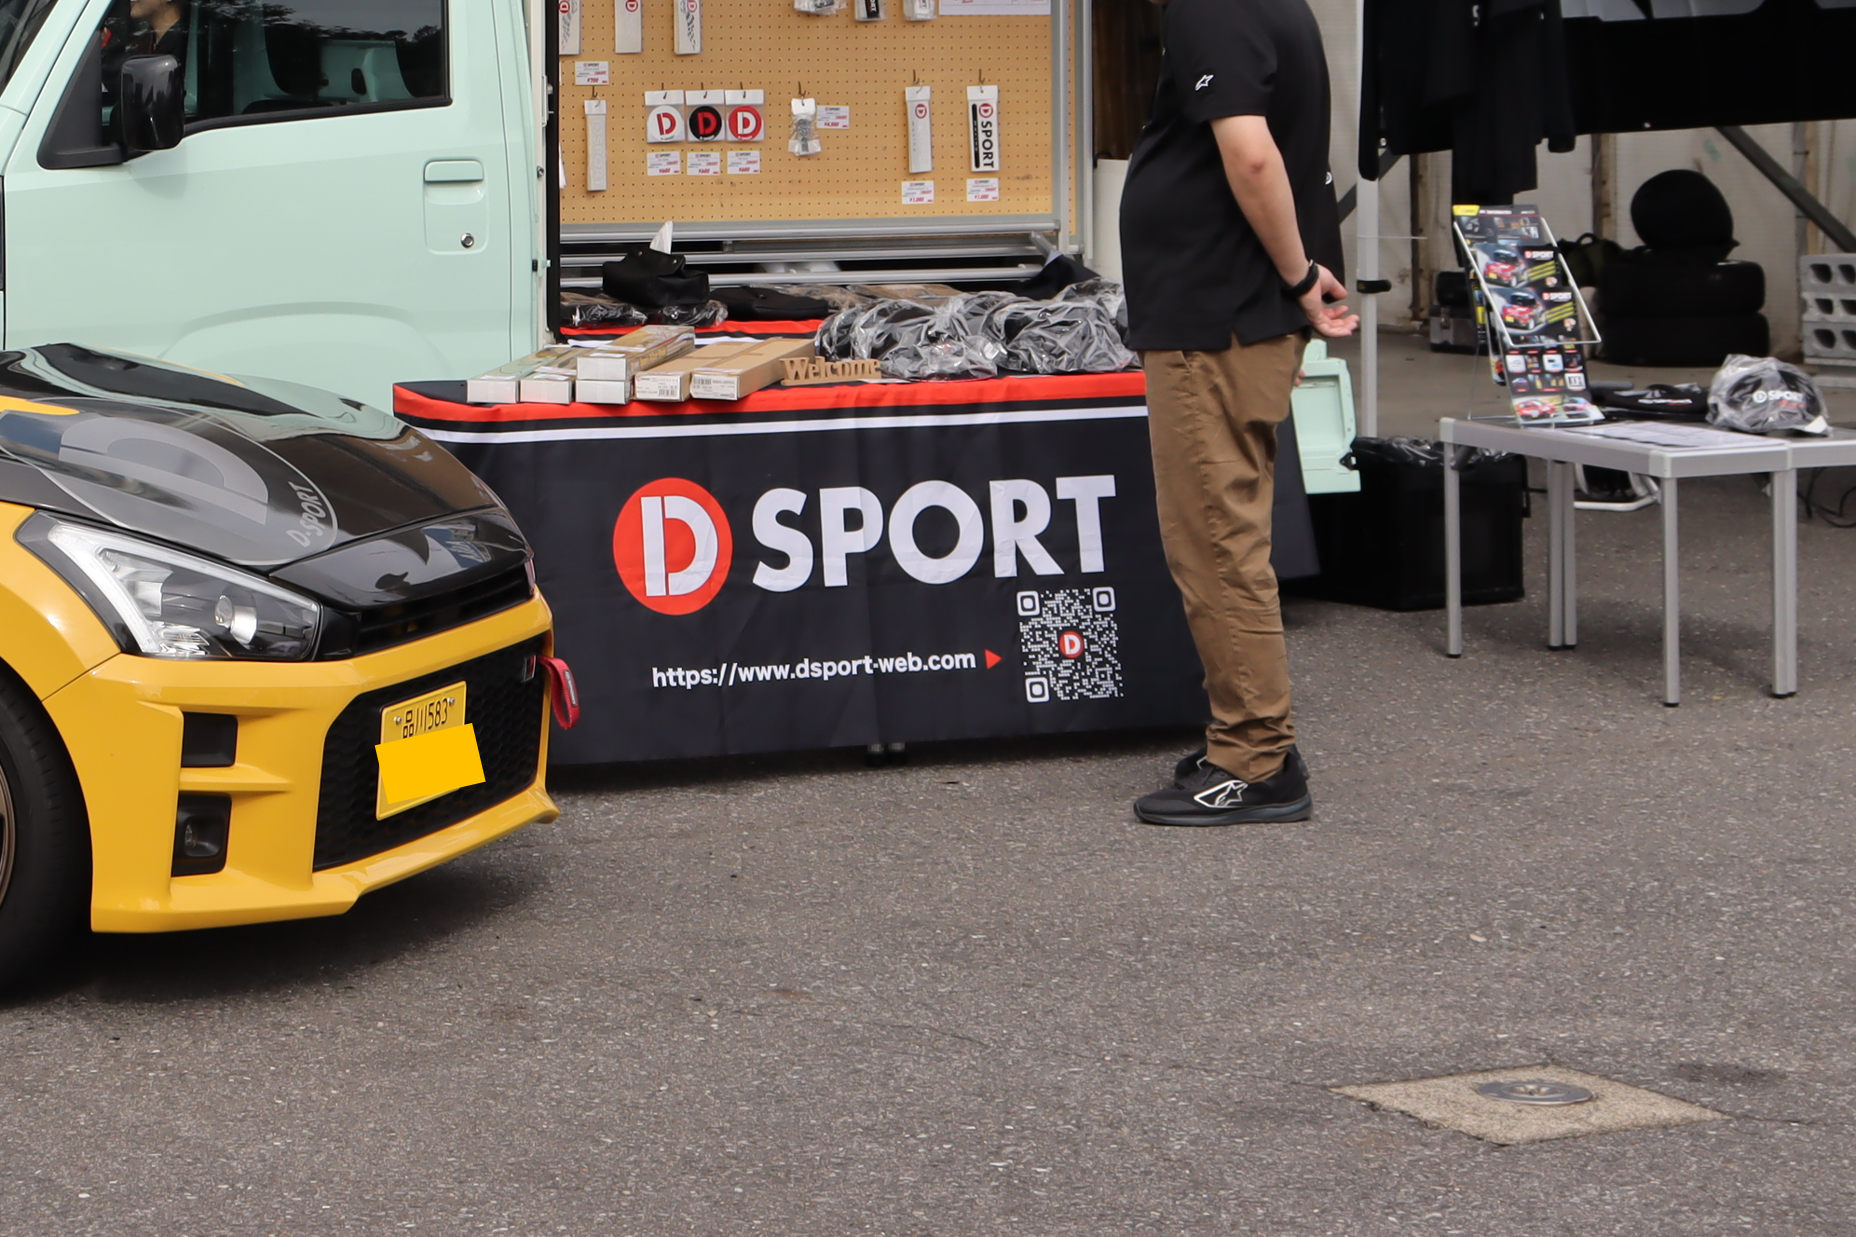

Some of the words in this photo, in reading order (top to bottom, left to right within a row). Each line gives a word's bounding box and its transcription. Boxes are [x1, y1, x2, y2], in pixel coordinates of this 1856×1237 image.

[656, 112, 677, 136] D
[697, 112, 719, 135] D
[737, 111, 756, 135] D
[981, 120, 995, 169] SPORT
[1532, 251, 1555, 259] SPORT
[1550, 292, 1572, 301] SPORT
[780, 357, 882, 382] Welcome
[638, 494, 720, 598] D
[750, 473, 1117, 594] SPORT
[1062, 631, 1082, 657] D
[652, 651, 977, 690] https://www.dsport-web.com
[428, 697, 449, 730] 583
